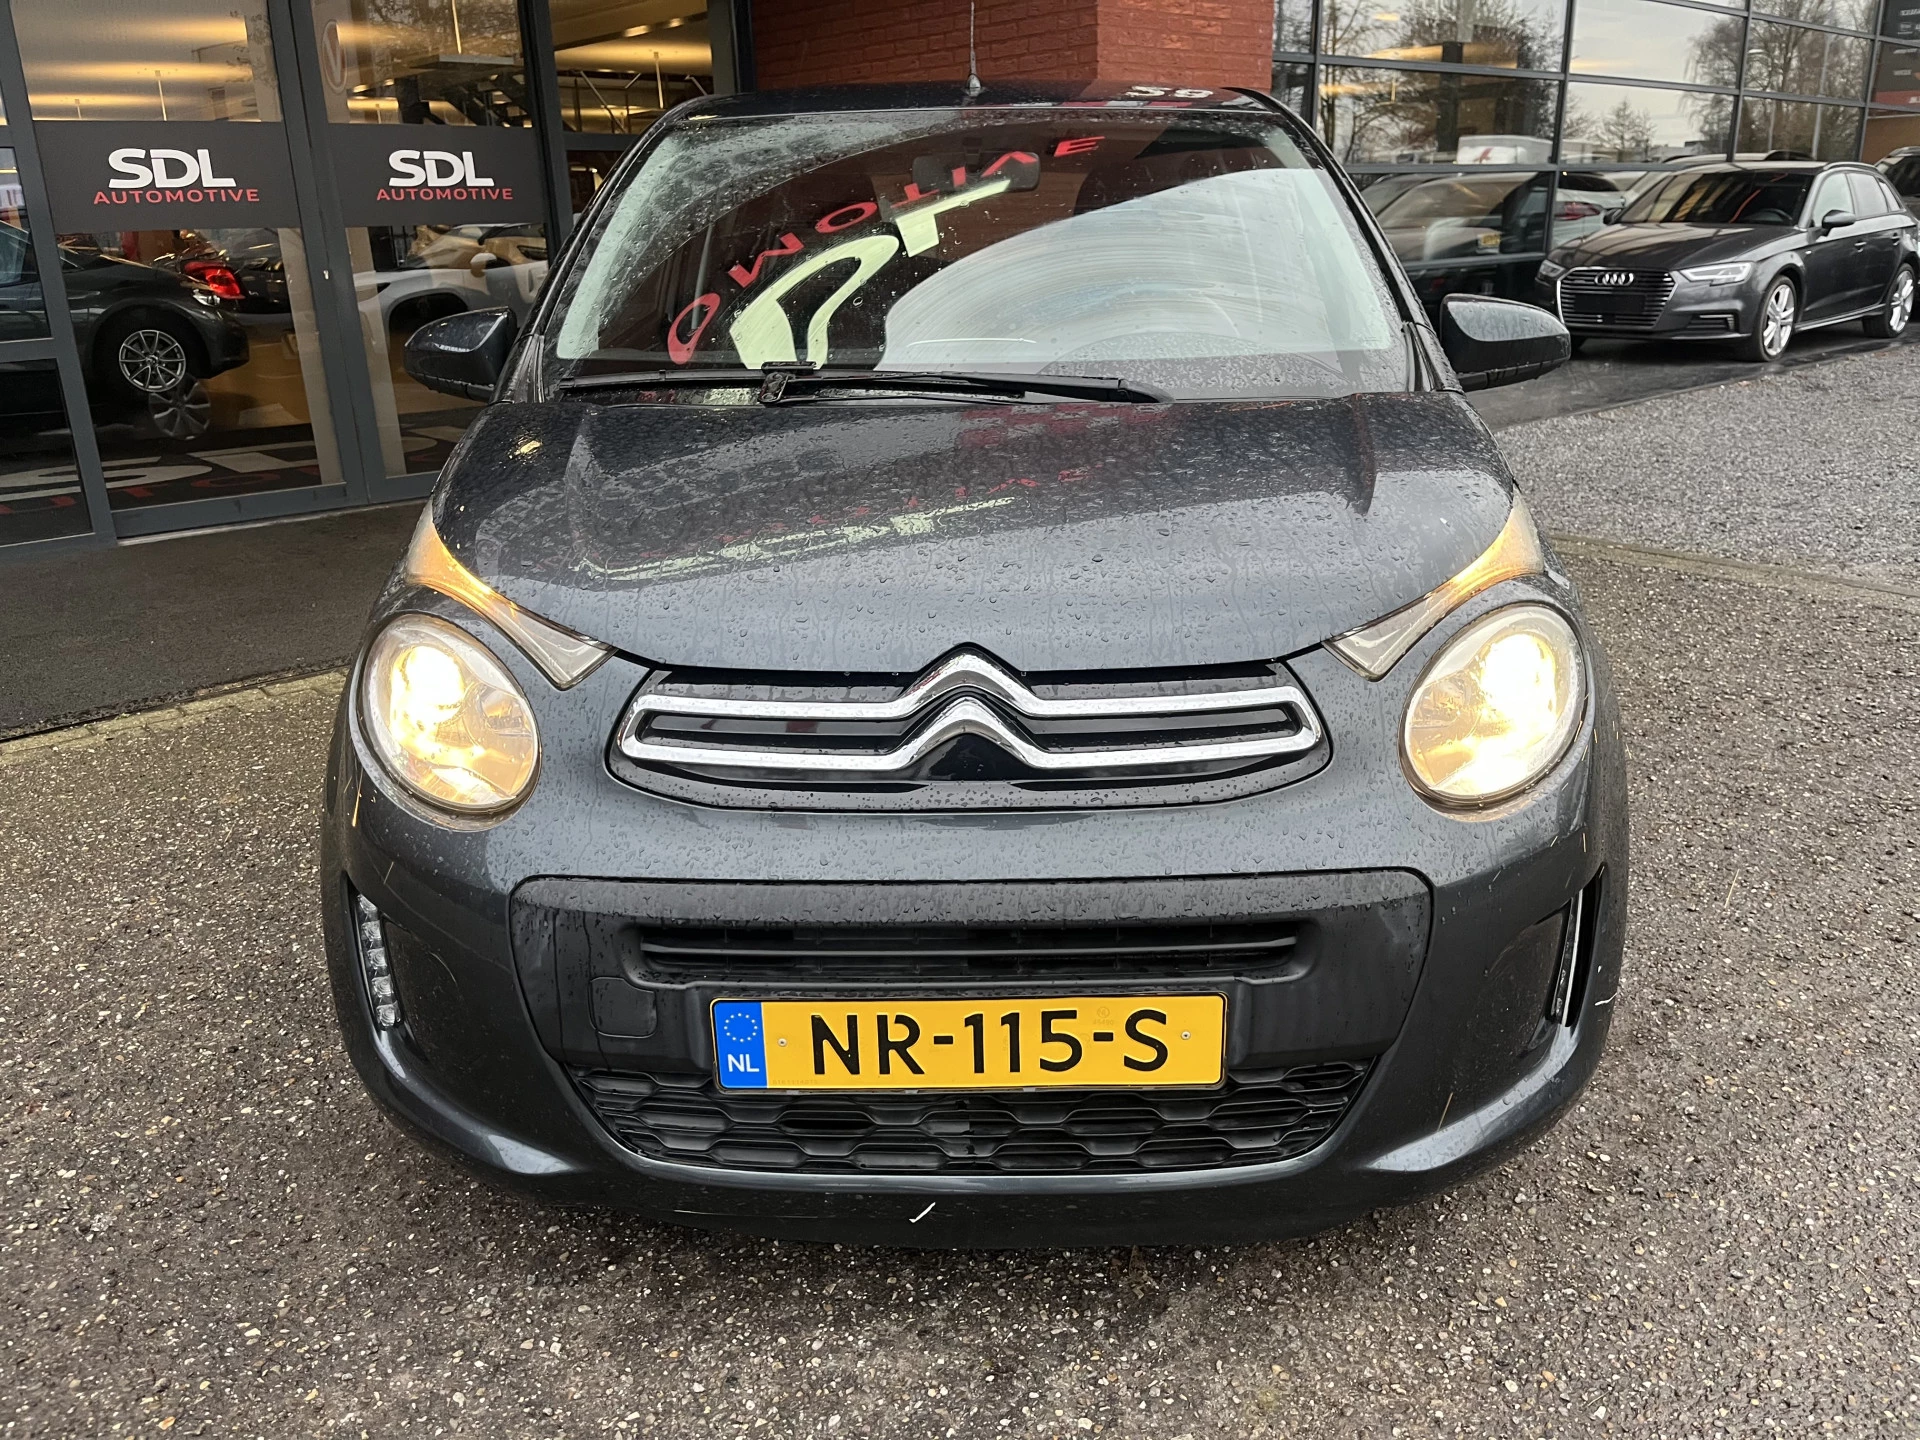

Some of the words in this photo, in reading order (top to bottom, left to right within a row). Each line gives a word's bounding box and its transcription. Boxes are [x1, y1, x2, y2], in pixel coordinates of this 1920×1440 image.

[108, 148, 236, 189] SDL
[388, 149, 495, 187] SDL
[93, 188, 260, 205] AUTOMOTIVE
[376, 187, 513, 201] AUTOMOTIVE
[811, 1009, 1168, 1075] NR-115-S
[727, 1053, 760, 1072] NL
